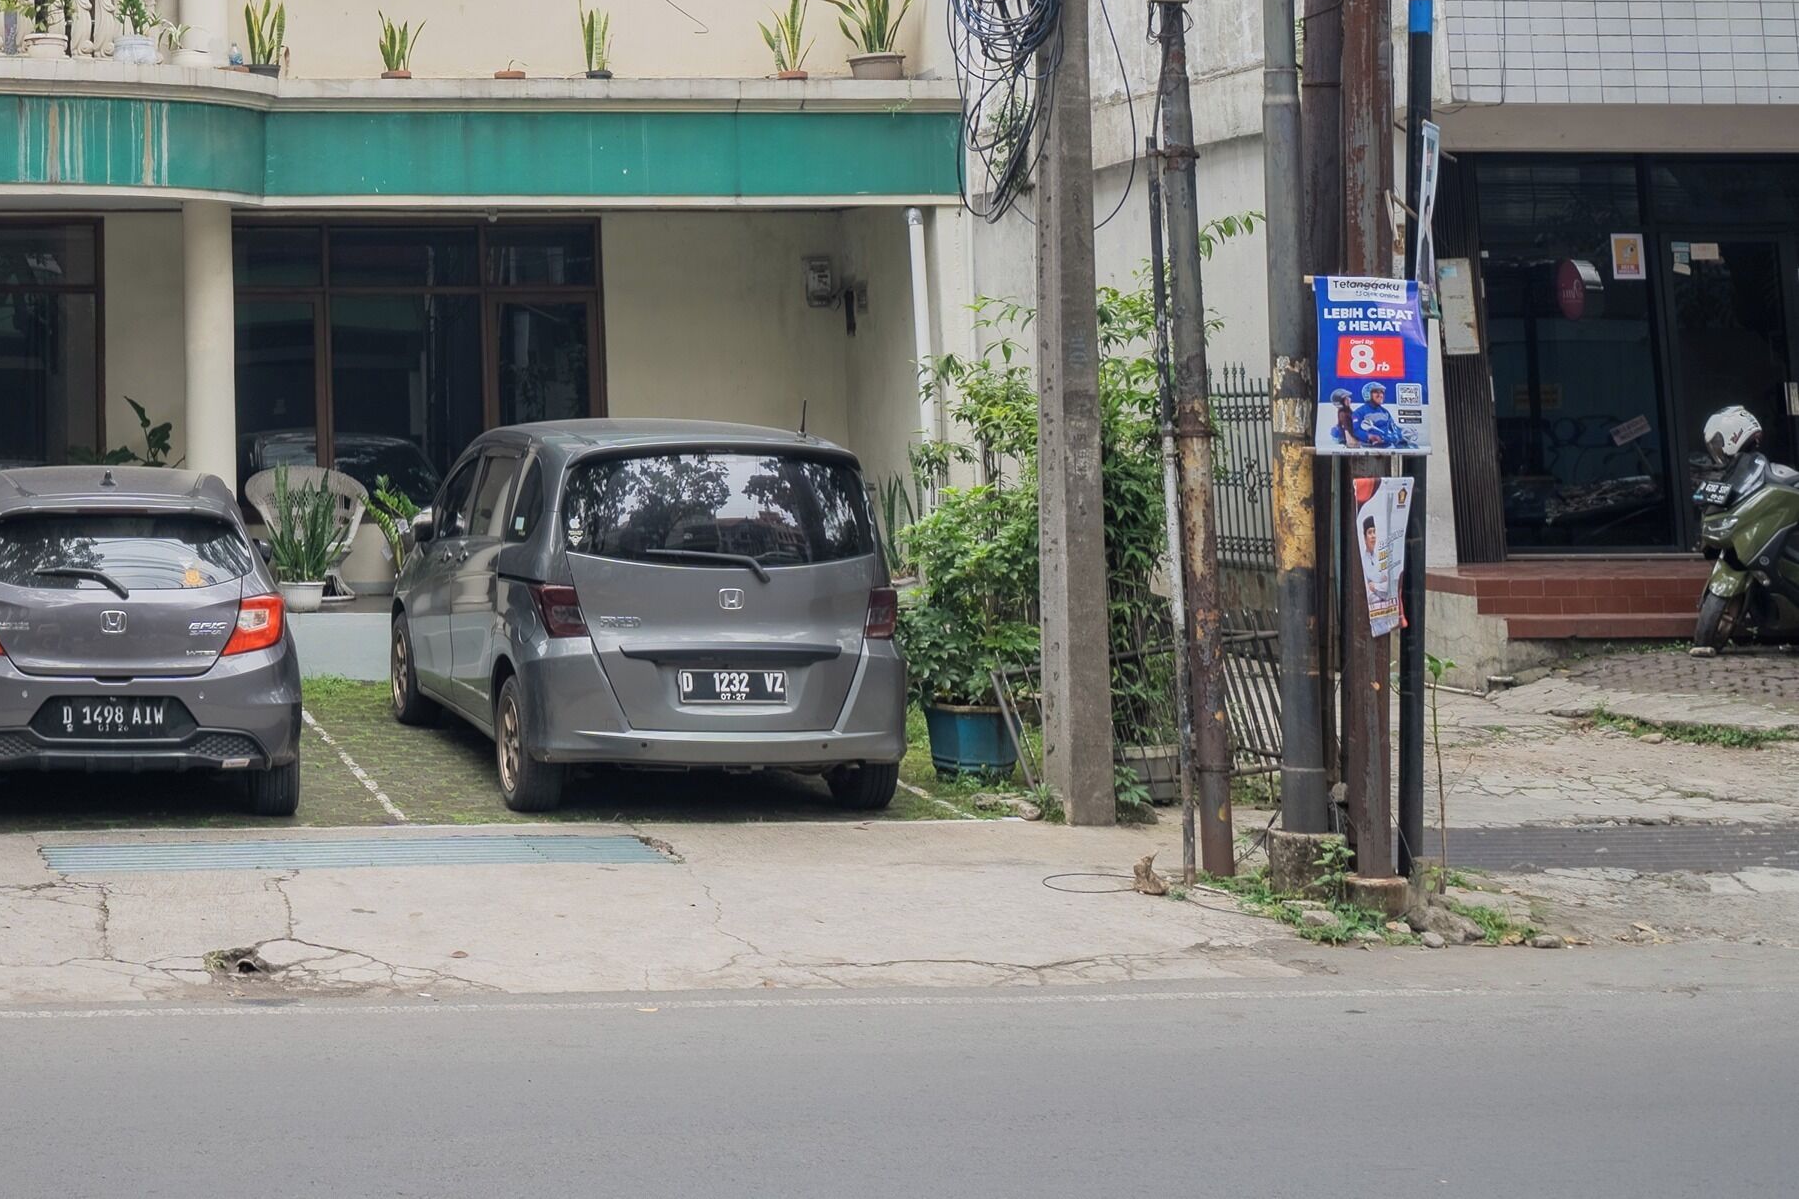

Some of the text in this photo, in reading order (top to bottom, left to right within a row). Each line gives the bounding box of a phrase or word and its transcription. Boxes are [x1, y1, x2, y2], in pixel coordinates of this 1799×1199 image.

[1333, 280, 1400, 291] Tetanggaku
[1324, 307, 1413, 320] LEBIH CEPAT
[1338, 321, 1402, 332] & HEMAT
[599, 615, 642, 628] FREED
[682, 672, 784, 693] D 1232 VZ
[62, 705, 163, 725] D 1498 AIW
